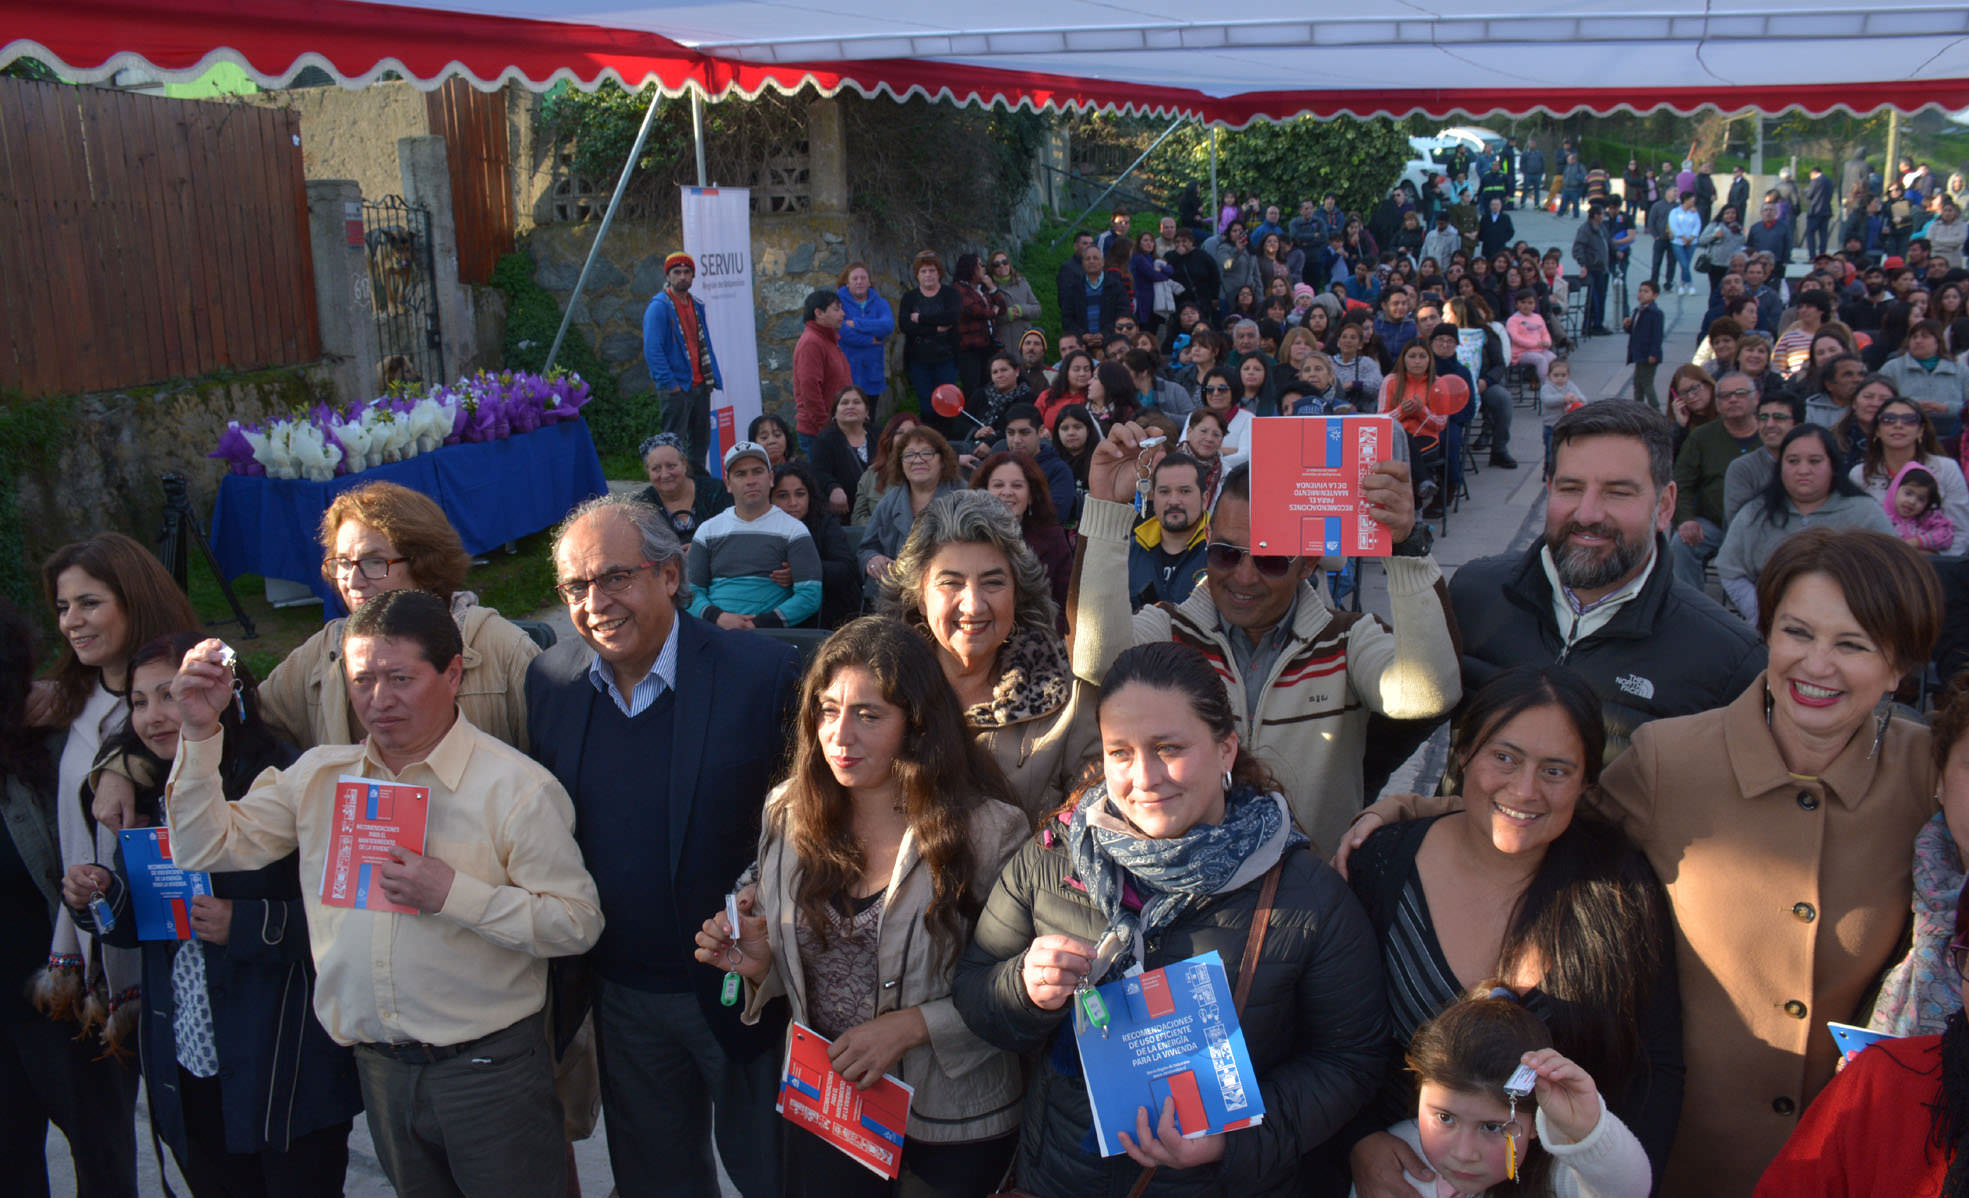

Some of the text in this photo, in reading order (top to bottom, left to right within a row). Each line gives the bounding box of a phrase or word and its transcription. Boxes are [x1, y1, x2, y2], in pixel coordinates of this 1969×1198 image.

[700, 252, 744, 277] SERVIU
[1122, 1015, 1194, 1042] RECOMENDACIONES
[1128, 1025, 1192, 1050] DE USO EFICIENTE
[1132, 1042, 1198, 1068] PARA LA VIVIENDA
[1136, 1035, 1190, 1057] DE LA ENERGÍA
